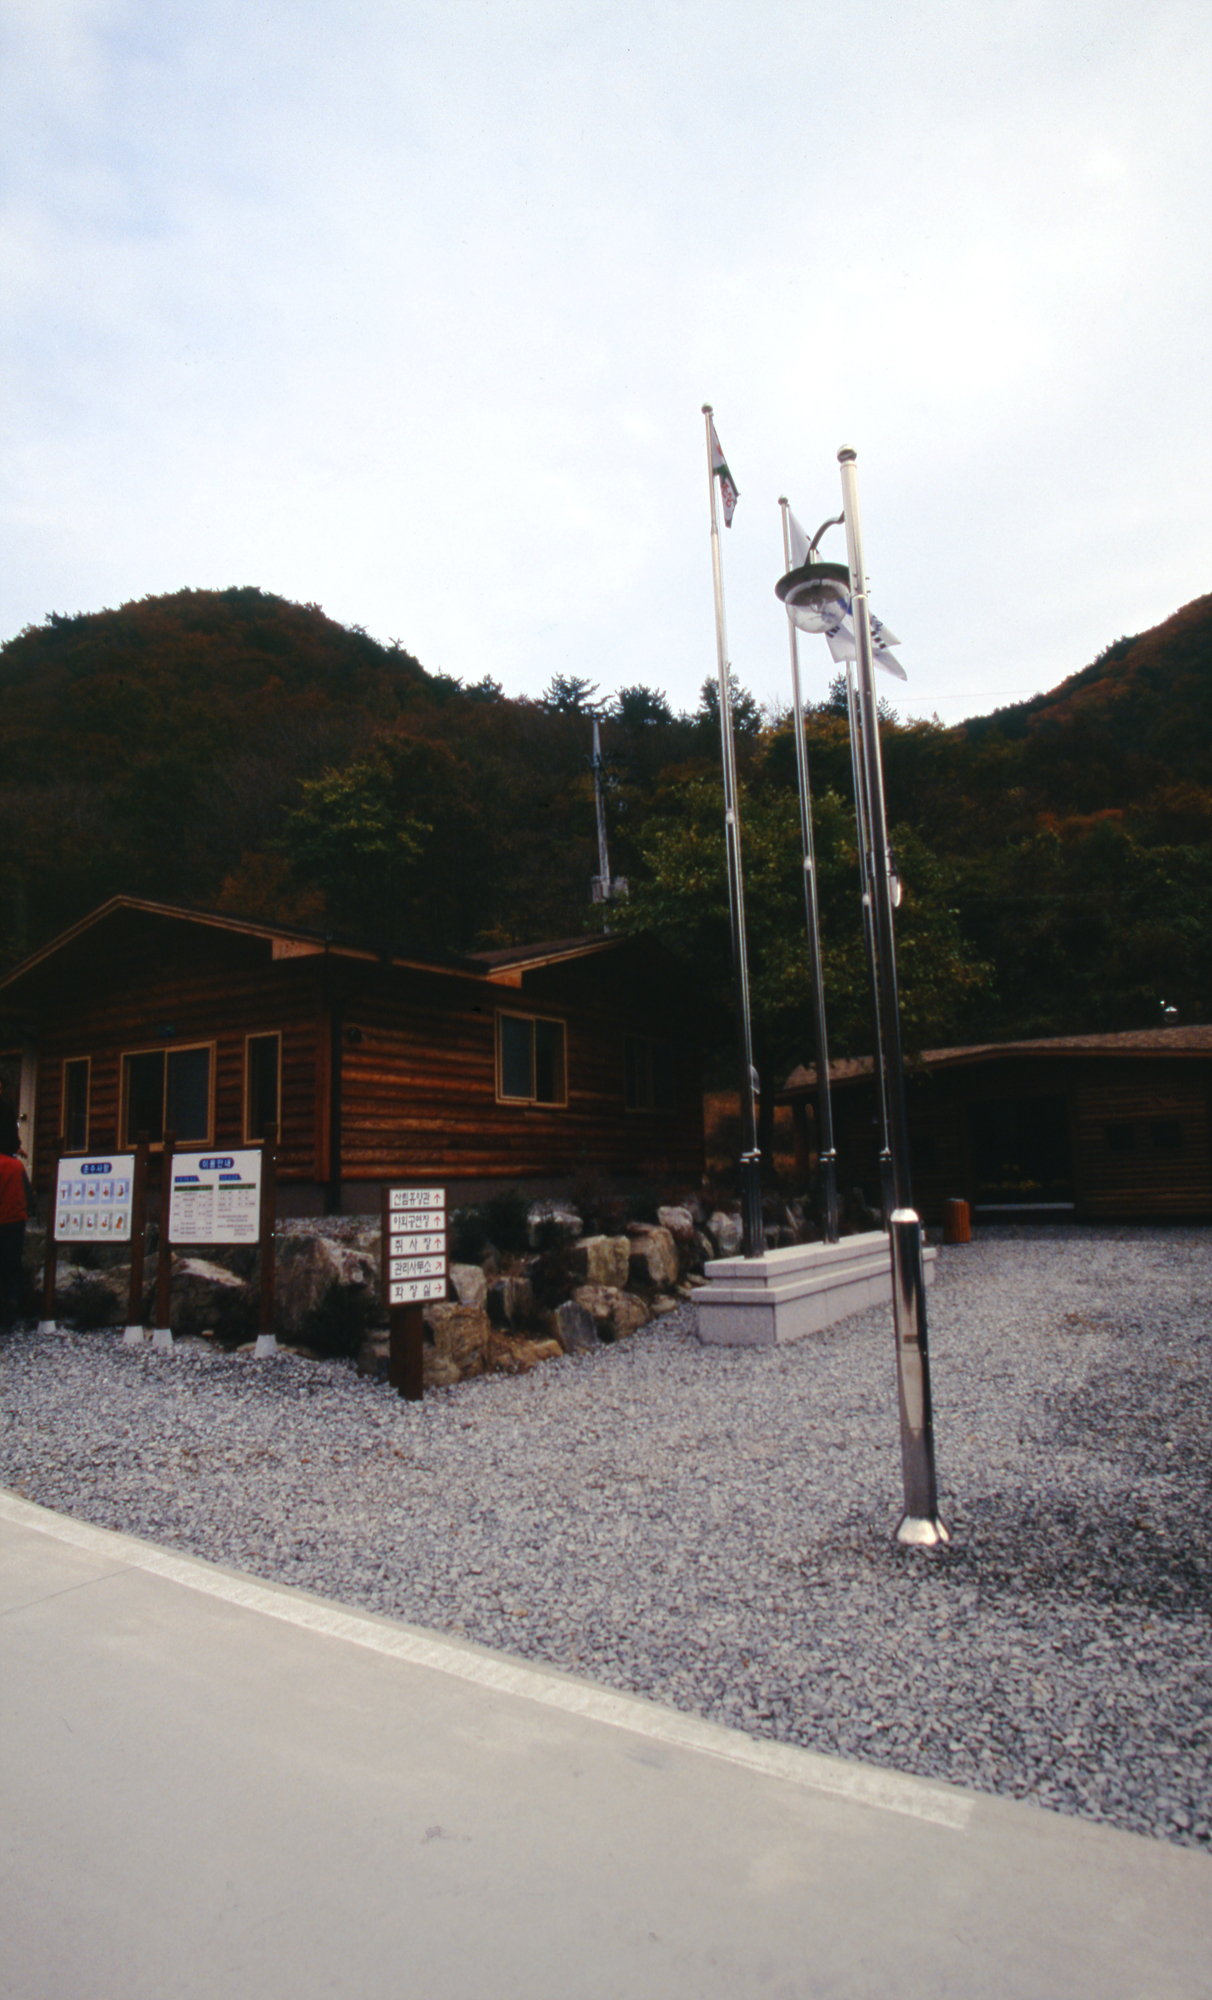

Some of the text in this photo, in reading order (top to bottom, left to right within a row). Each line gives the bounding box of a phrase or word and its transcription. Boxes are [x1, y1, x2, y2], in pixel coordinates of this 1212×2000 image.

[394, 1192, 430, 1206] 산림휴양관
[393, 1214, 430, 1229] 야외공연장
[395, 1260, 431, 1276] 관리사무소
